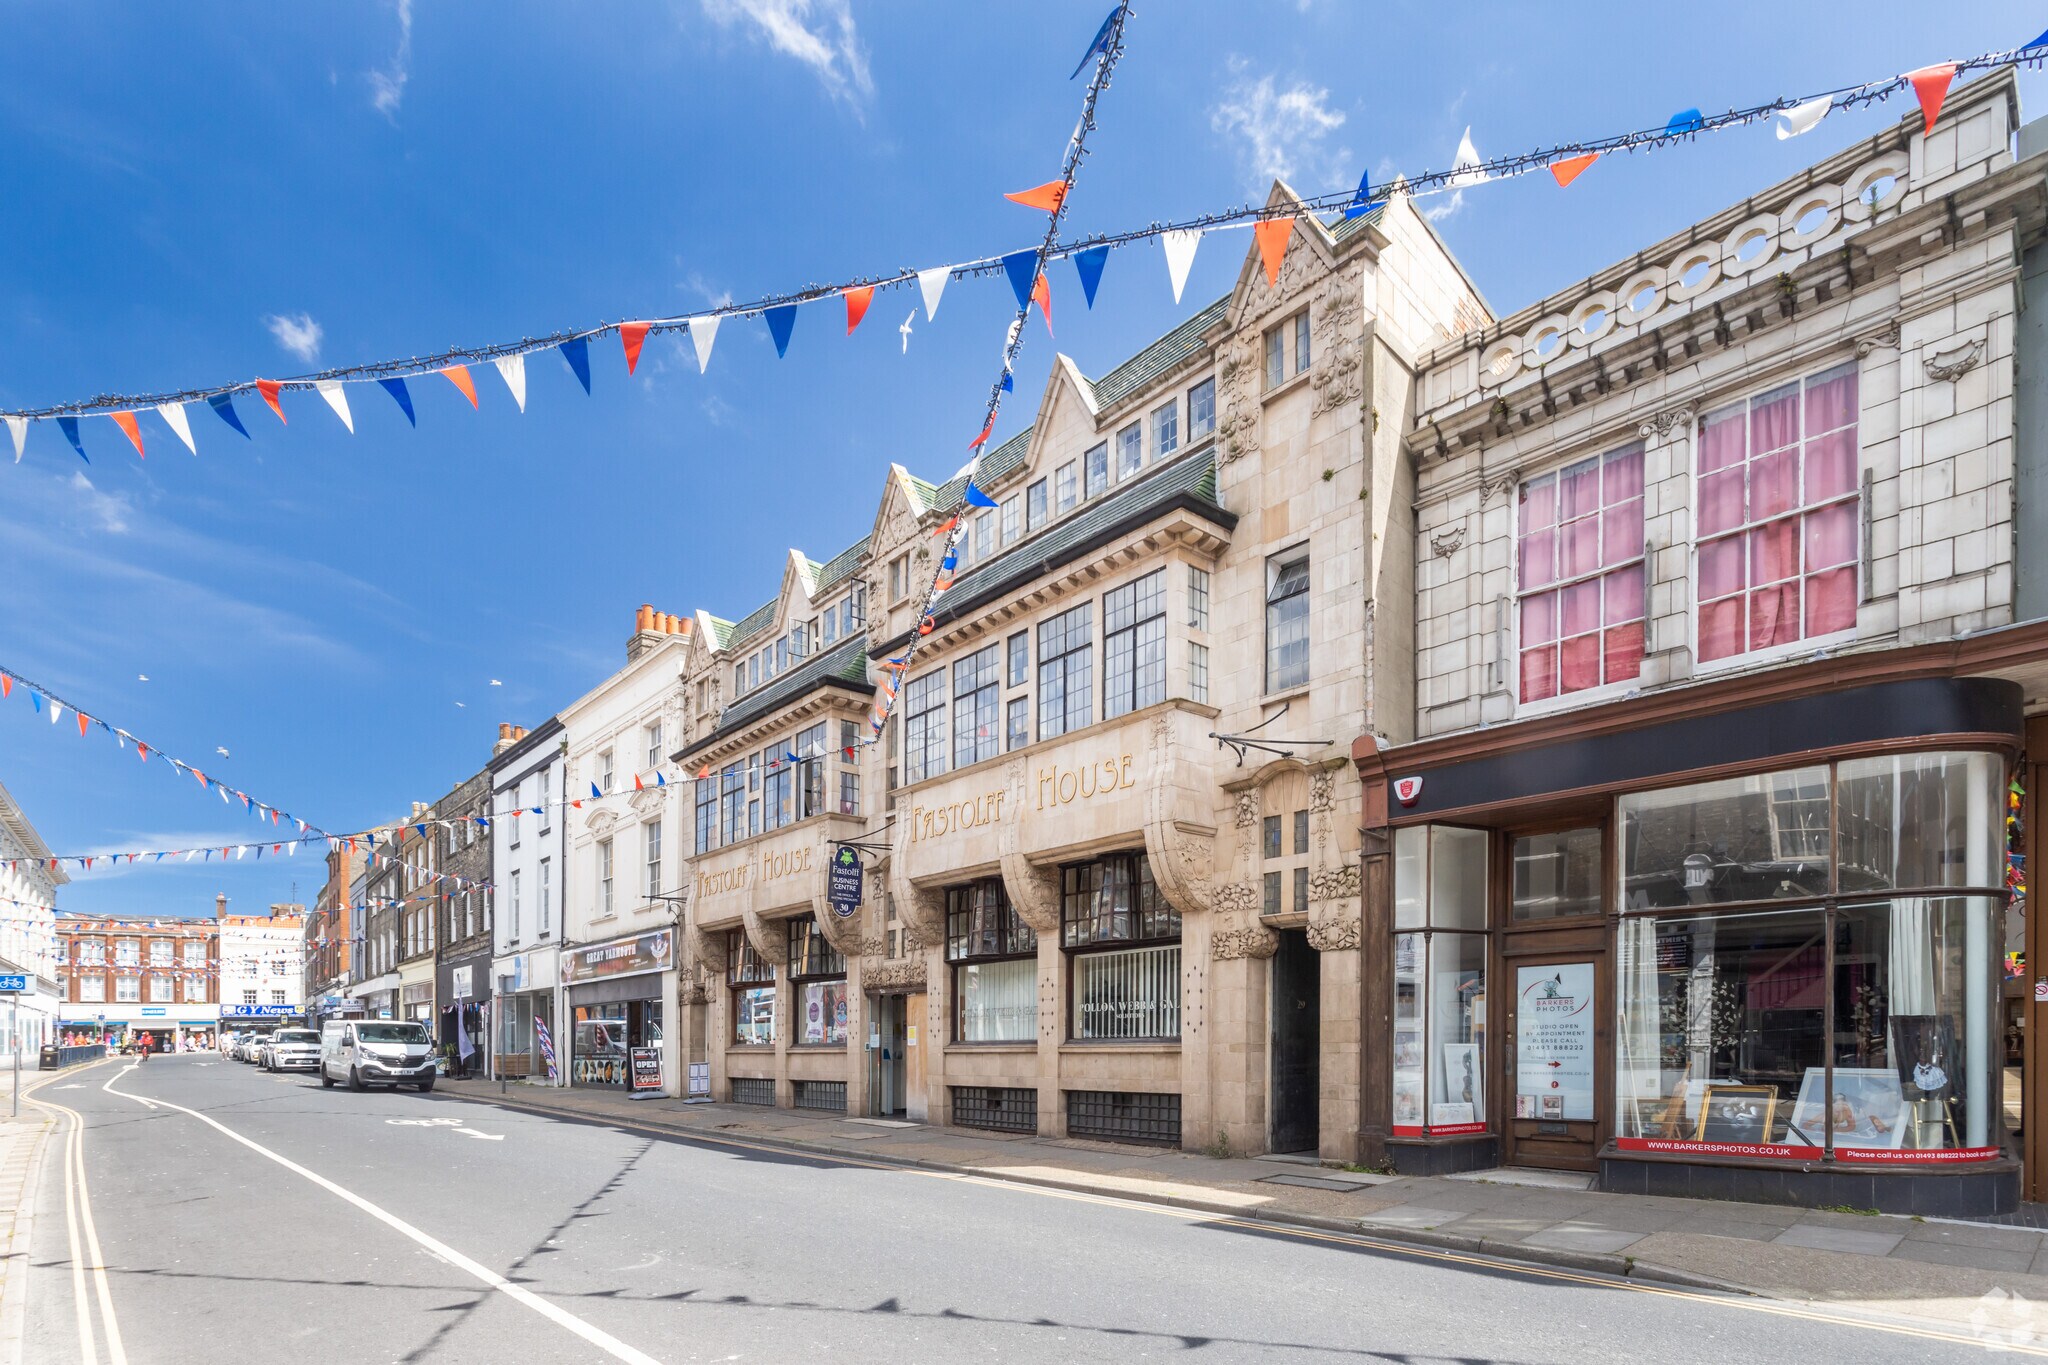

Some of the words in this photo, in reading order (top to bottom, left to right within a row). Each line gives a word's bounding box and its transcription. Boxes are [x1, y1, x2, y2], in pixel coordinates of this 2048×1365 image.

[911, 789, 1006, 843] FASTOLFF
[1036, 753, 1136, 810] HOUSE
[697, 864, 748, 898] FASTOLFF
[763, 847, 812, 881] HOUSE
[832, 865, 859, 876] Fastolff
[832, 877, 859, 886] BUSINESS
[833, 884, 857, 892] CENTRE
[839, 903, 849, 911] 30
[586, 951, 605, 964] GREAT
[605, 944, 636, 960] YARMOUTH
[237, 1006, 247, 1014] G
[250, 1006, 260, 1014] Y
[261, 1006, 294, 1014] News
[1079, 1003, 1115, 1014] POLLOK
[1118, 1001, 1146, 1011] WEBB
[1149, 1000, 1156, 1010] &
[636, 1060, 657, 1068] OPEN
[1432, 1125, 1483, 1133] WWW.BARKERSPHOTOS.CO.UK
[1647, 1141, 1791, 1156] WWW.BARKERSPHOTOS.CO.UK
[1847, 1150, 1876, 1158] Please
